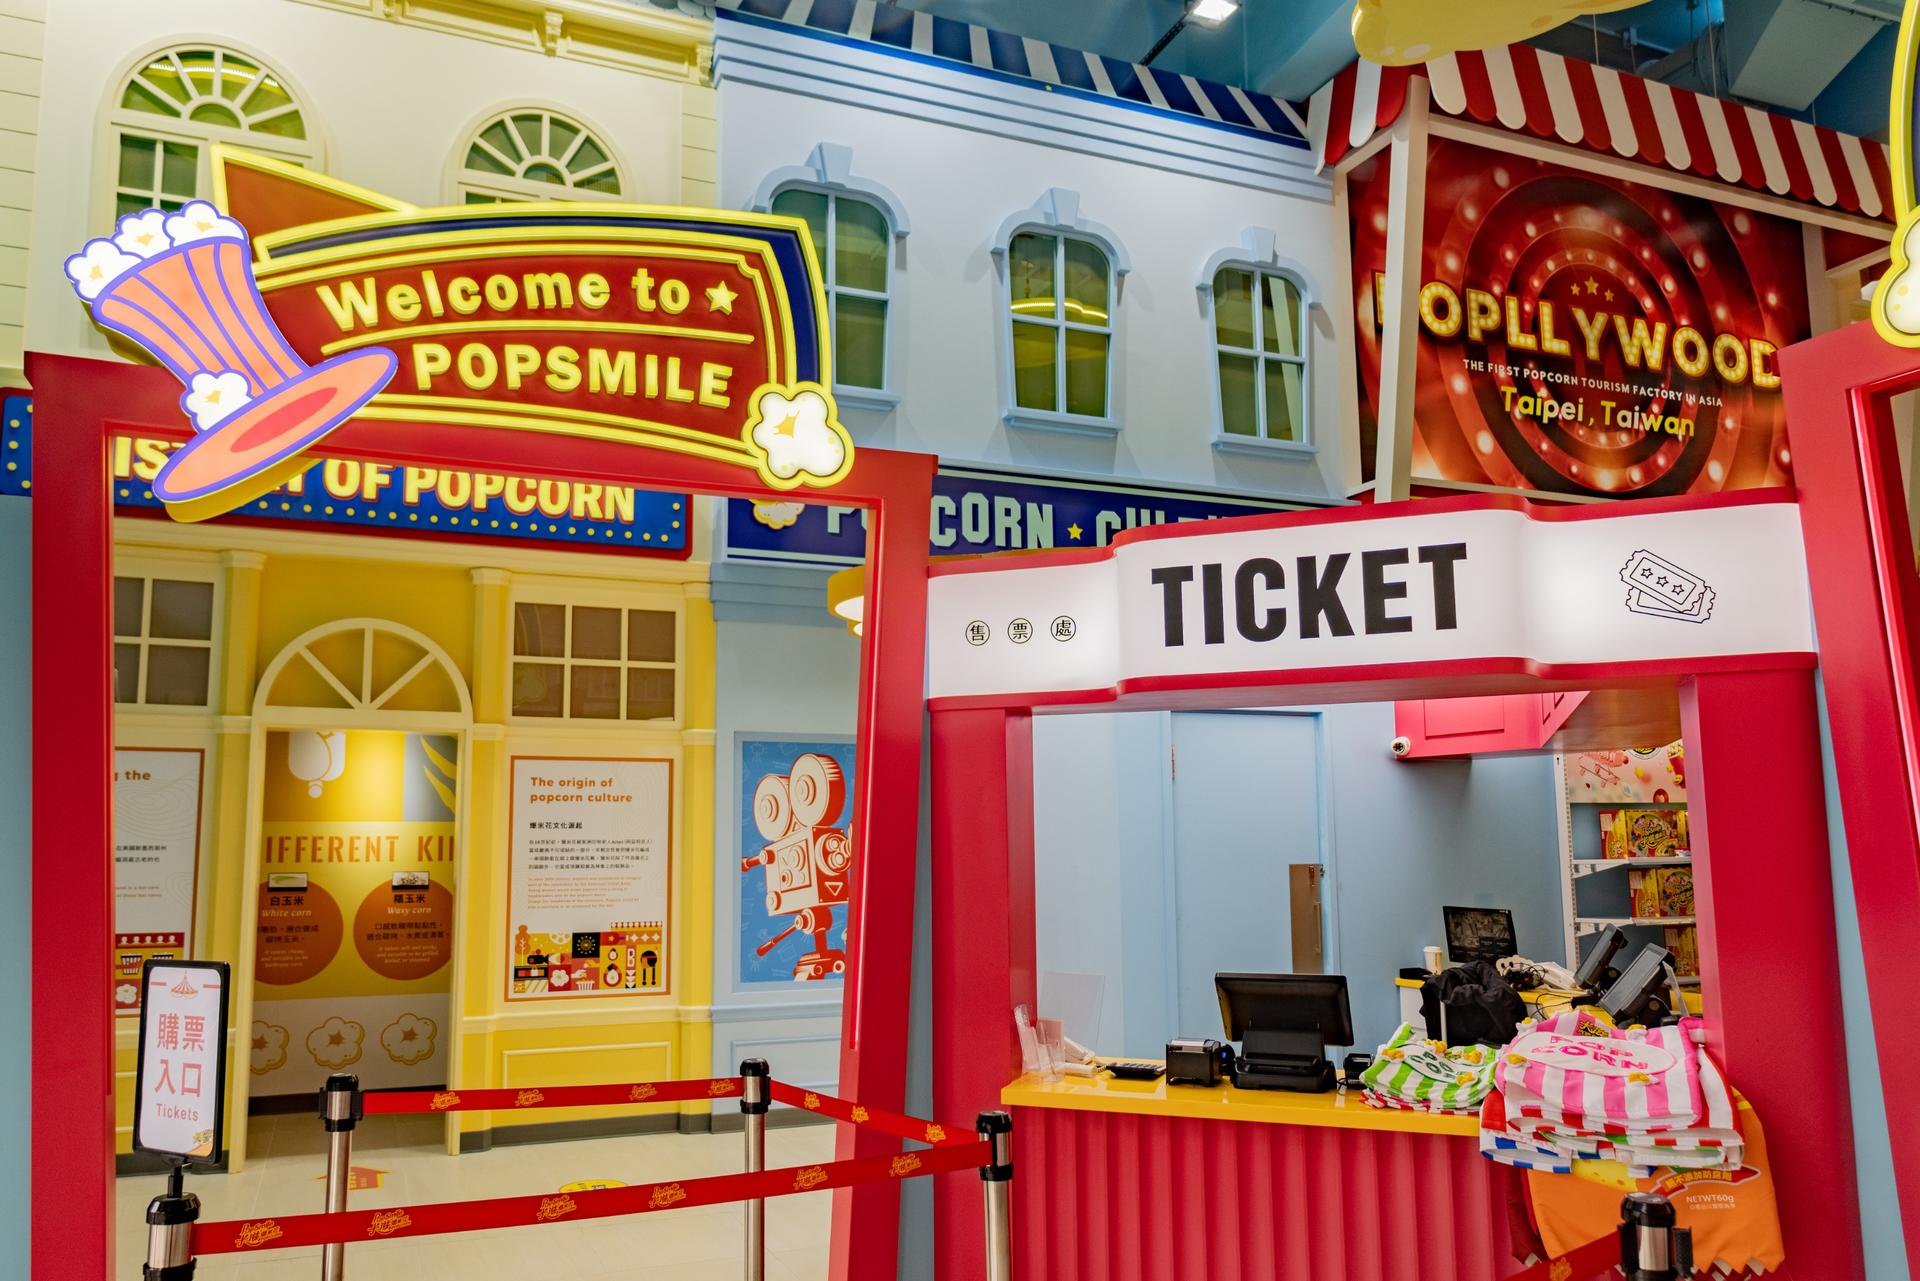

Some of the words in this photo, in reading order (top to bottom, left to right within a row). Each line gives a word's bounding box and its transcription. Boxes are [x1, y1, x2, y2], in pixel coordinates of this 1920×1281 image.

[316, 268, 611, 332] Welcome
[631, 268, 690, 314] to
[411, 342, 733, 409] POPSMILE
[1463, 359, 1485, 372] THE
[1487, 362, 1519, 378] FIRST
[1523, 367, 1579, 386] POPCORN
[1581, 376, 1631, 395] TOURISM
[1633, 384, 1683, 403] FACTORY
[1685, 393, 1697, 404] IN
[1698, 395, 1724, 408] ASIA
[1600, 400, 1696, 438] Taiwan
[324, 459, 395, 500] OF
[403, 466, 635, 523] POPCORN
[1151, 542, 1467, 647] TICKET
[125, 769, 152, 781] the
[530, 776, 554, 788] The
[558, 776, 596, 790] origin
[600, 776, 614, 788] of
[530, 792, 583, 804] popcorn
[587, 791, 633, 803] culture
[261, 909, 289, 918] White
[290, 909, 313, 918] corn
[270, 895, 305, 906] 白玉米
[387, 906, 410, 916] Waxy
[412, 906, 432, 915] corn
[157, 1013, 206, 1051] 購票
[1531, 1044, 1649, 1071] CORN
[154, 1058, 203, 1097] 入口
[156, 1103, 199, 1122] Tickets
